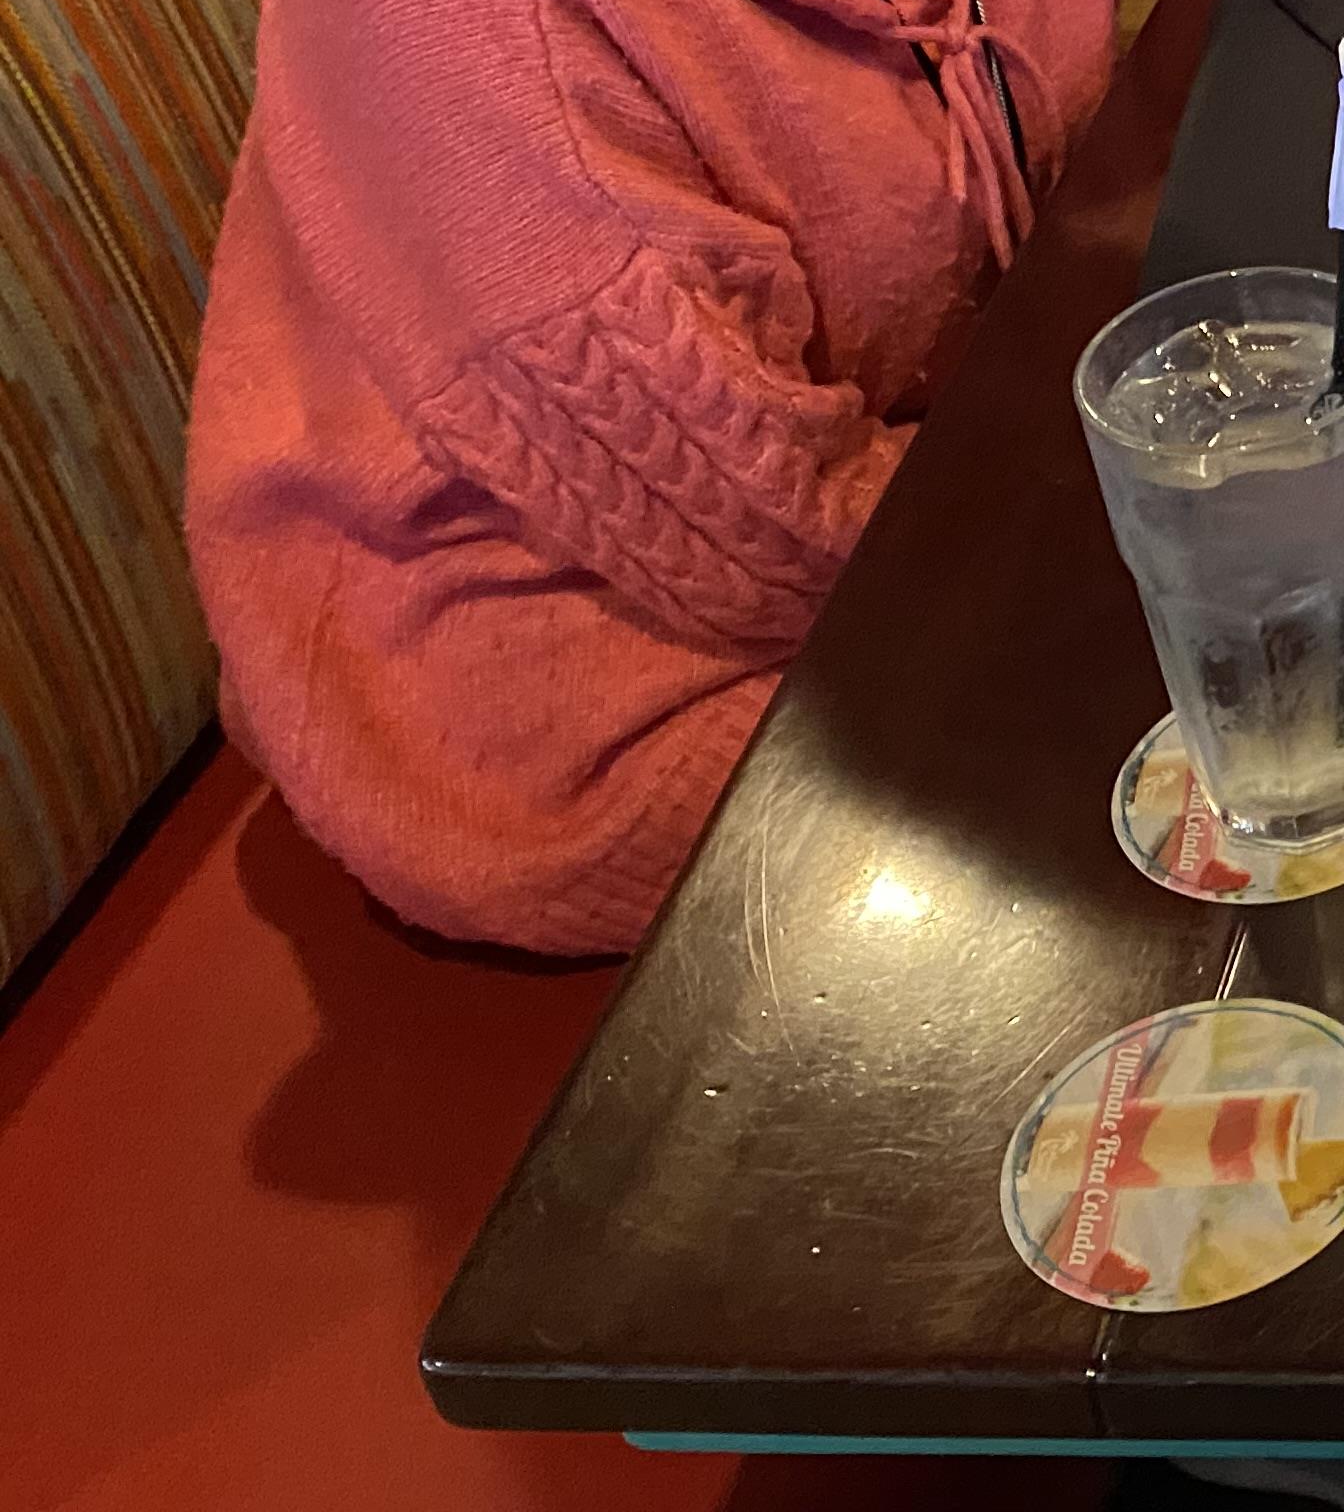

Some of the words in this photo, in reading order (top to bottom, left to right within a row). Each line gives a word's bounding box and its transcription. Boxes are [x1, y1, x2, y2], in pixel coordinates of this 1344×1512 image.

[1178, 813, 1209, 872] Colada
[1100, 1043, 1142, 1131] Ultimate
[1068, 1189, 1109, 1265] Colada
